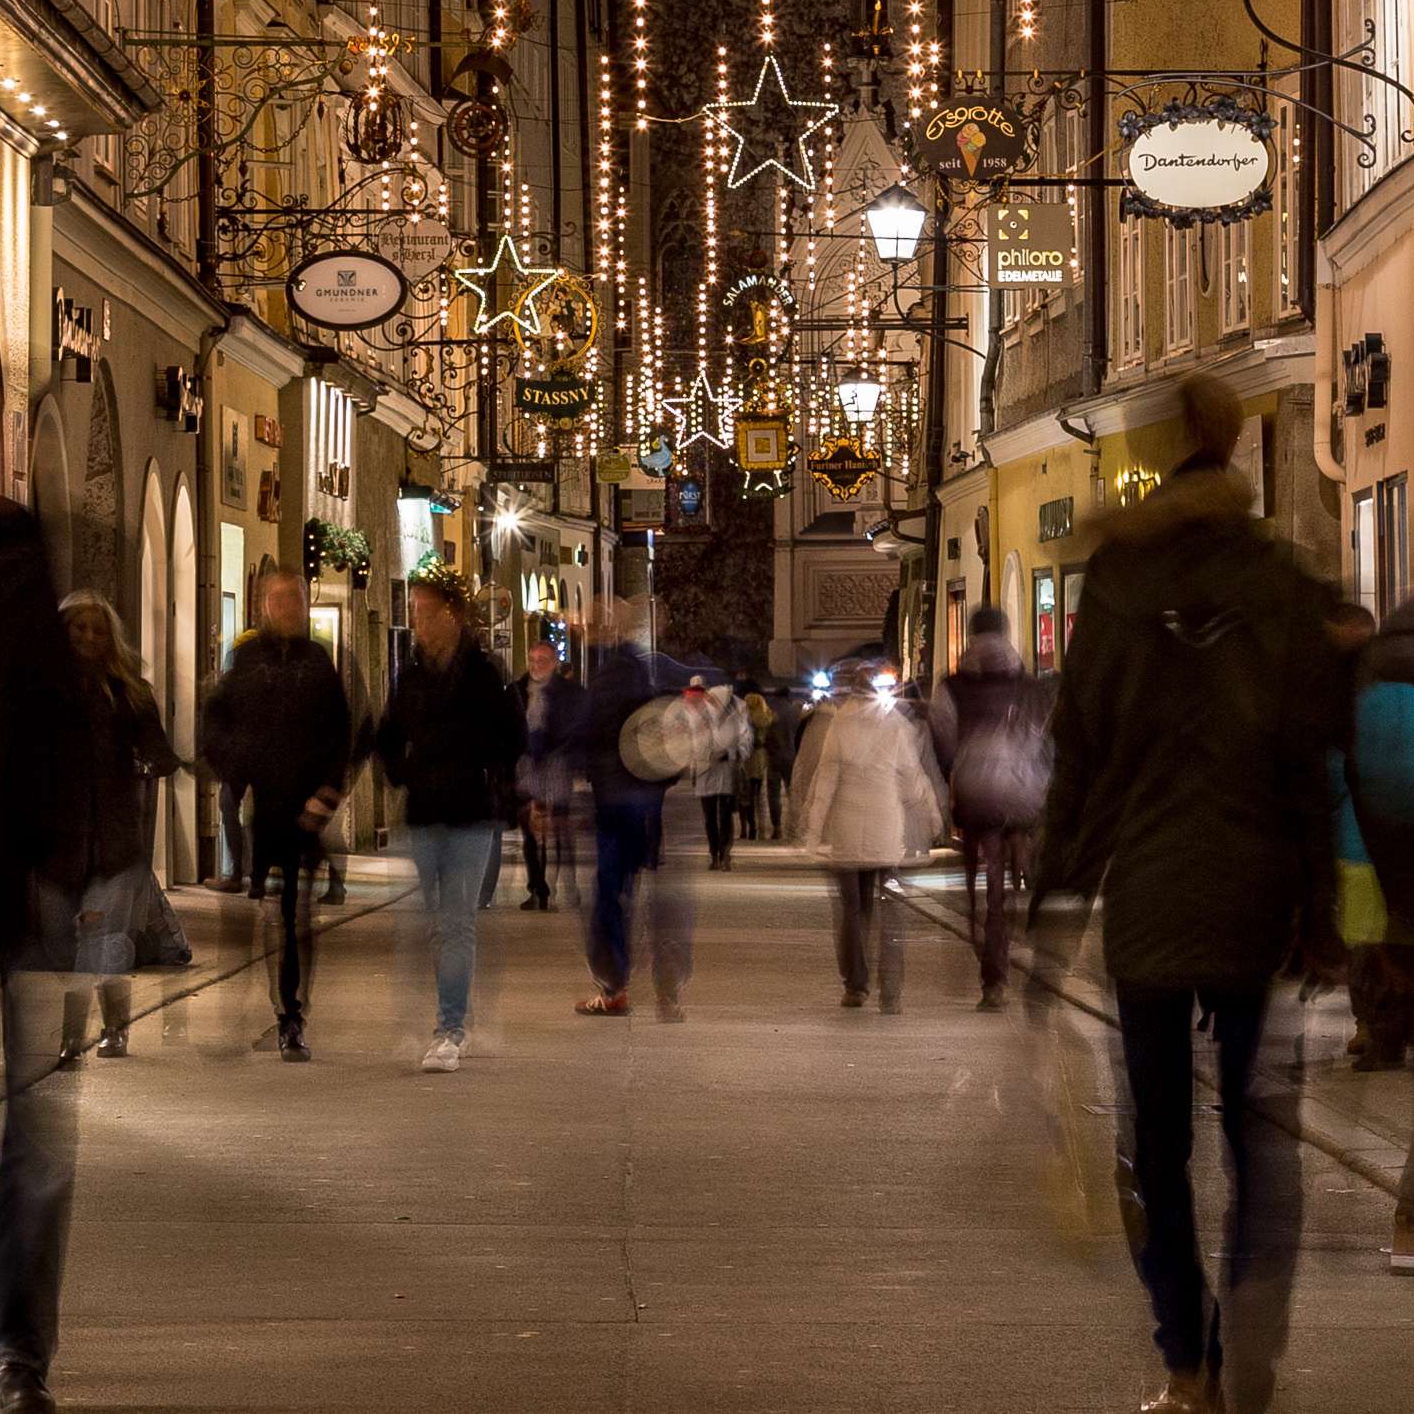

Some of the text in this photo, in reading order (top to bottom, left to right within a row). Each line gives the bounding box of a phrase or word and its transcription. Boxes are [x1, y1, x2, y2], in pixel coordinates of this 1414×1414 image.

[939, 158, 1007, 169] seit 1958
[1138, 152, 1258, 171] Dantendorfer
[997, 249, 1063, 270] philoro
[997, 270, 1063, 282] EDELMETALLE
[316, 288, 379, 297] GMUNDNER
[723, 275, 794, 308] SALAMANDER
[522, 387, 590, 405] STASSNY
